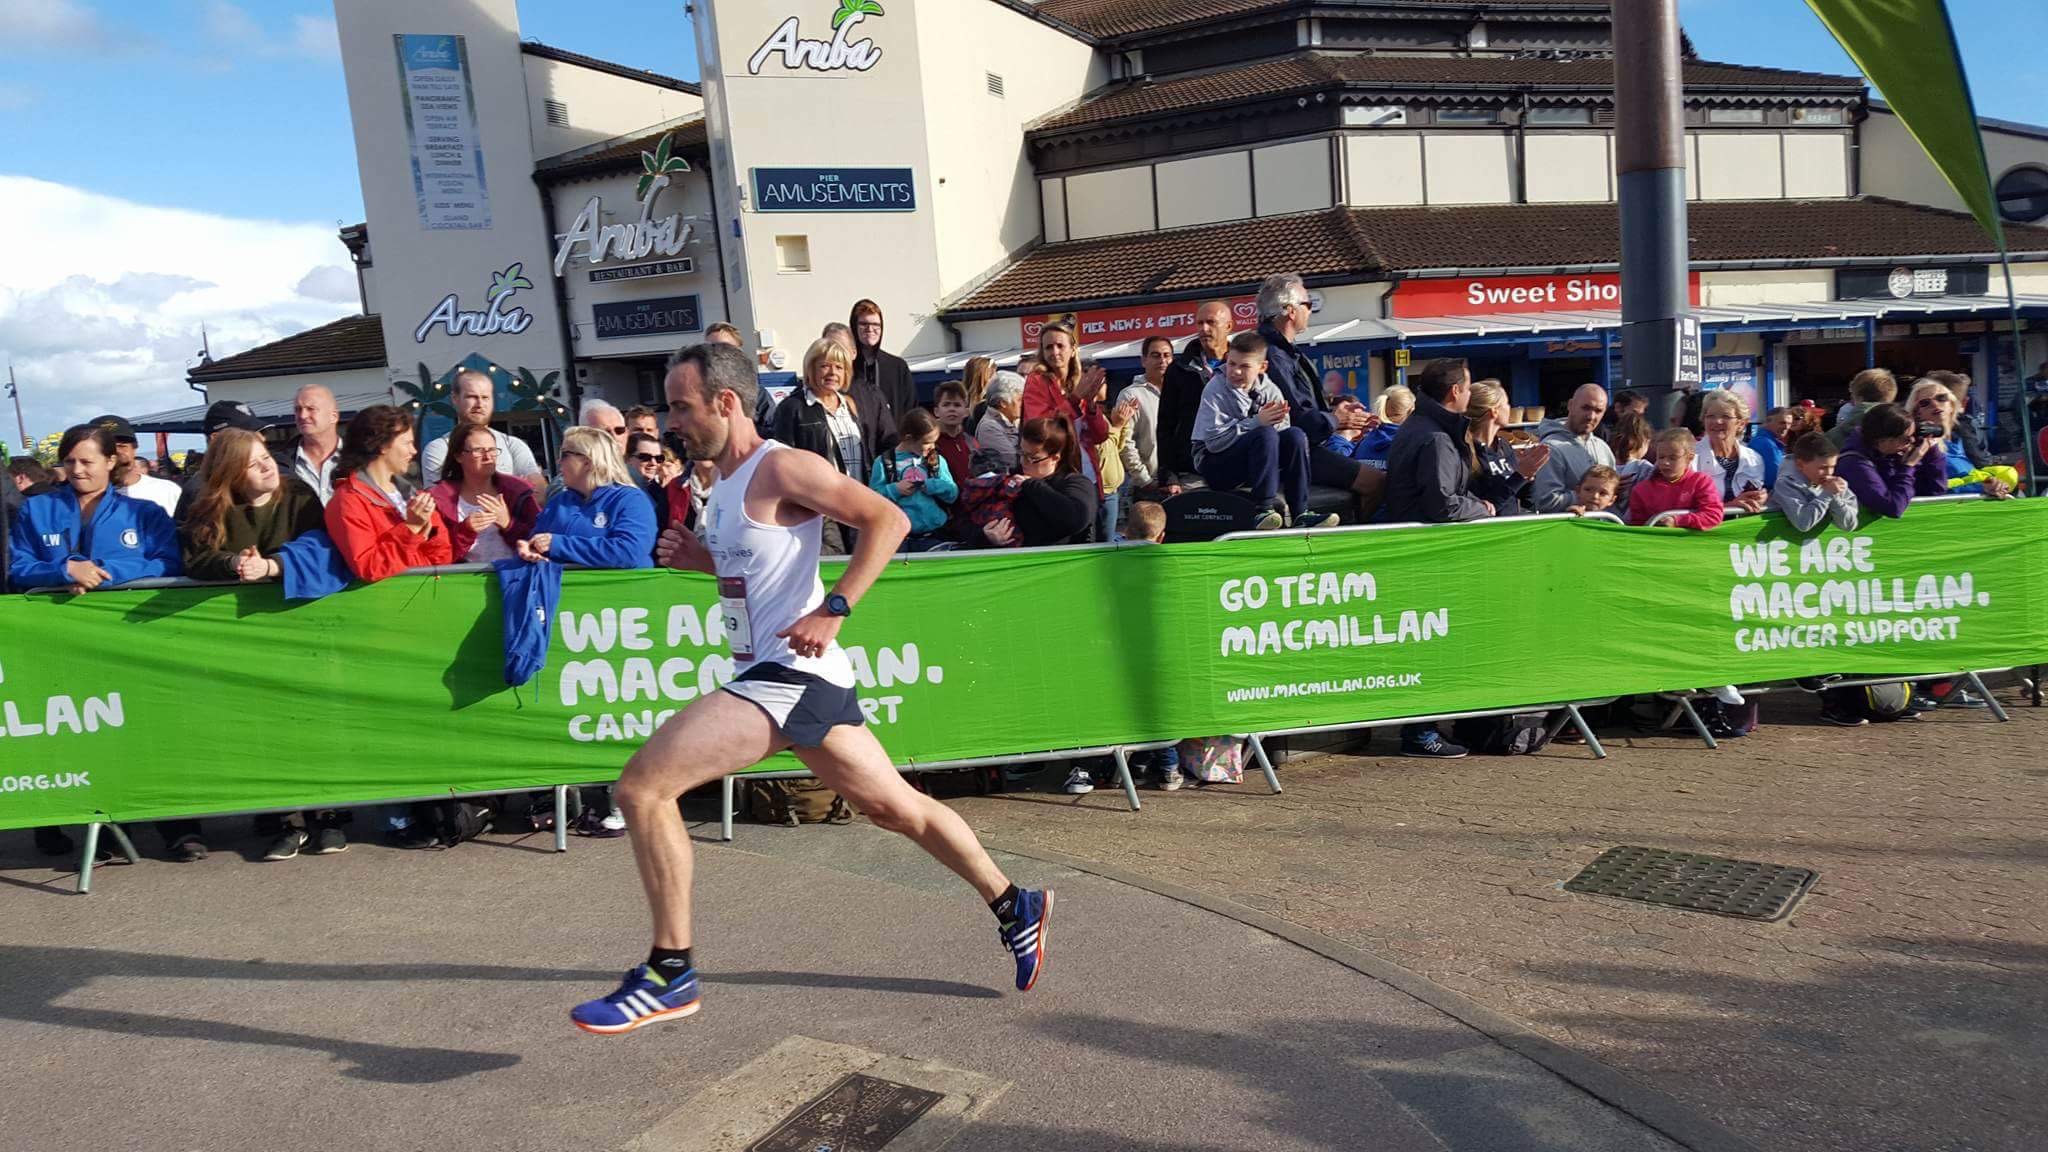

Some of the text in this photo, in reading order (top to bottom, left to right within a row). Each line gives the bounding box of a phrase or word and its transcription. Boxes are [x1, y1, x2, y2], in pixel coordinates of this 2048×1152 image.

[748, 11, 882, 75] Aruba
[764, 183, 911, 203] AMUSEMENTS
[819, 174, 840, 182] PIER
[555, 174, 692, 277] Aruba
[593, 265, 650, 281] RESTAURANT
[666, 262, 686, 273] BAR
[1913, 278, 1948, 292] REEF
[1467, 281, 1556, 304] Sweet
[415, 287, 533, 343] Aruba
[598, 309, 695, 331] AMUSEMENTS
[1082, 313, 1195, 334] PIER NEWS & GIFTS
[1322, 354, 1362, 369] News
[1730, 536, 1875, 578] WE ARE
[1220, 572, 1376, 611] GO TEAM
[1730, 572, 1990, 621] MACMILLAN.
[559, 604, 728, 653] WE AR
[1221, 608, 1448, 657] MACMILLAN
[1735, 615, 1961, 652] CANCER SUPPORT
[1227, 672, 1421, 702] WWW.MACMILLAN.ORG.UK
